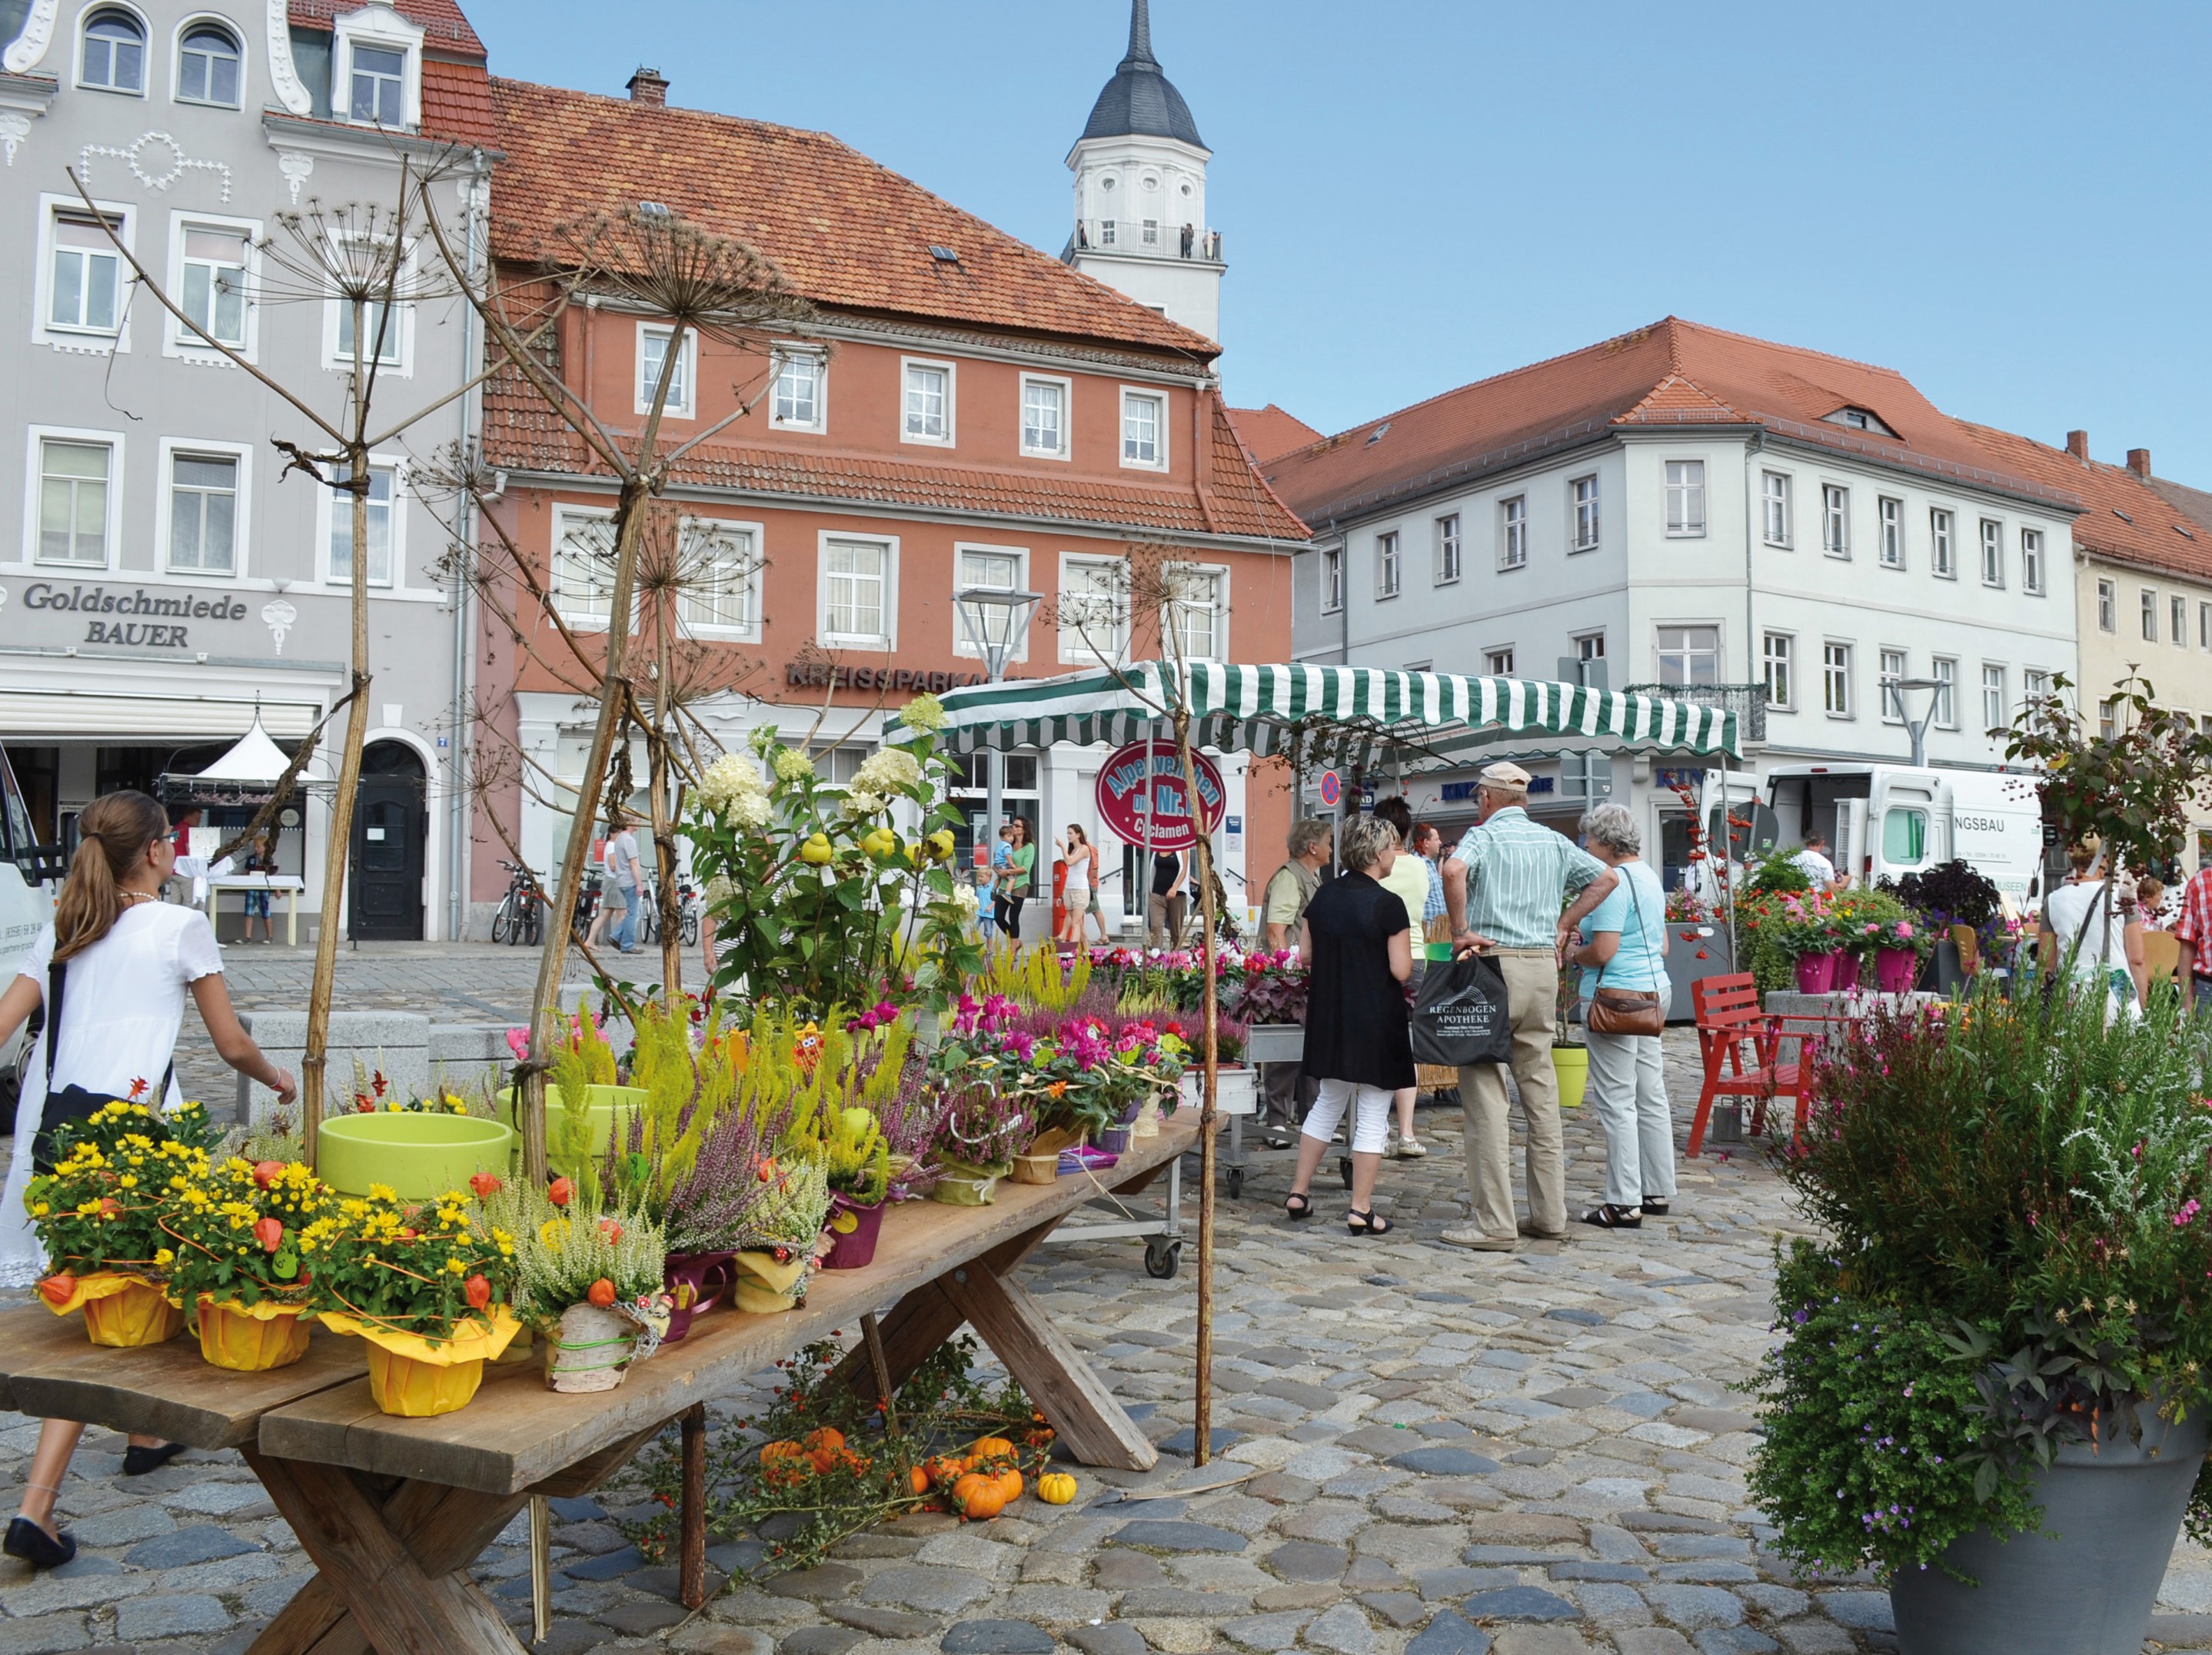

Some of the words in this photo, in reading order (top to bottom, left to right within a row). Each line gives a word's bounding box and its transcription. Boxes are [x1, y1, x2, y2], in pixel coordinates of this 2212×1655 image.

[23, 583, 247, 620] Goldschmiede
[85, 621, 188, 647] BAUER
[1429, 1005, 1496, 1014] REGENBOGEN
[1436, 1015, 1489, 1024] APOTHEKE
